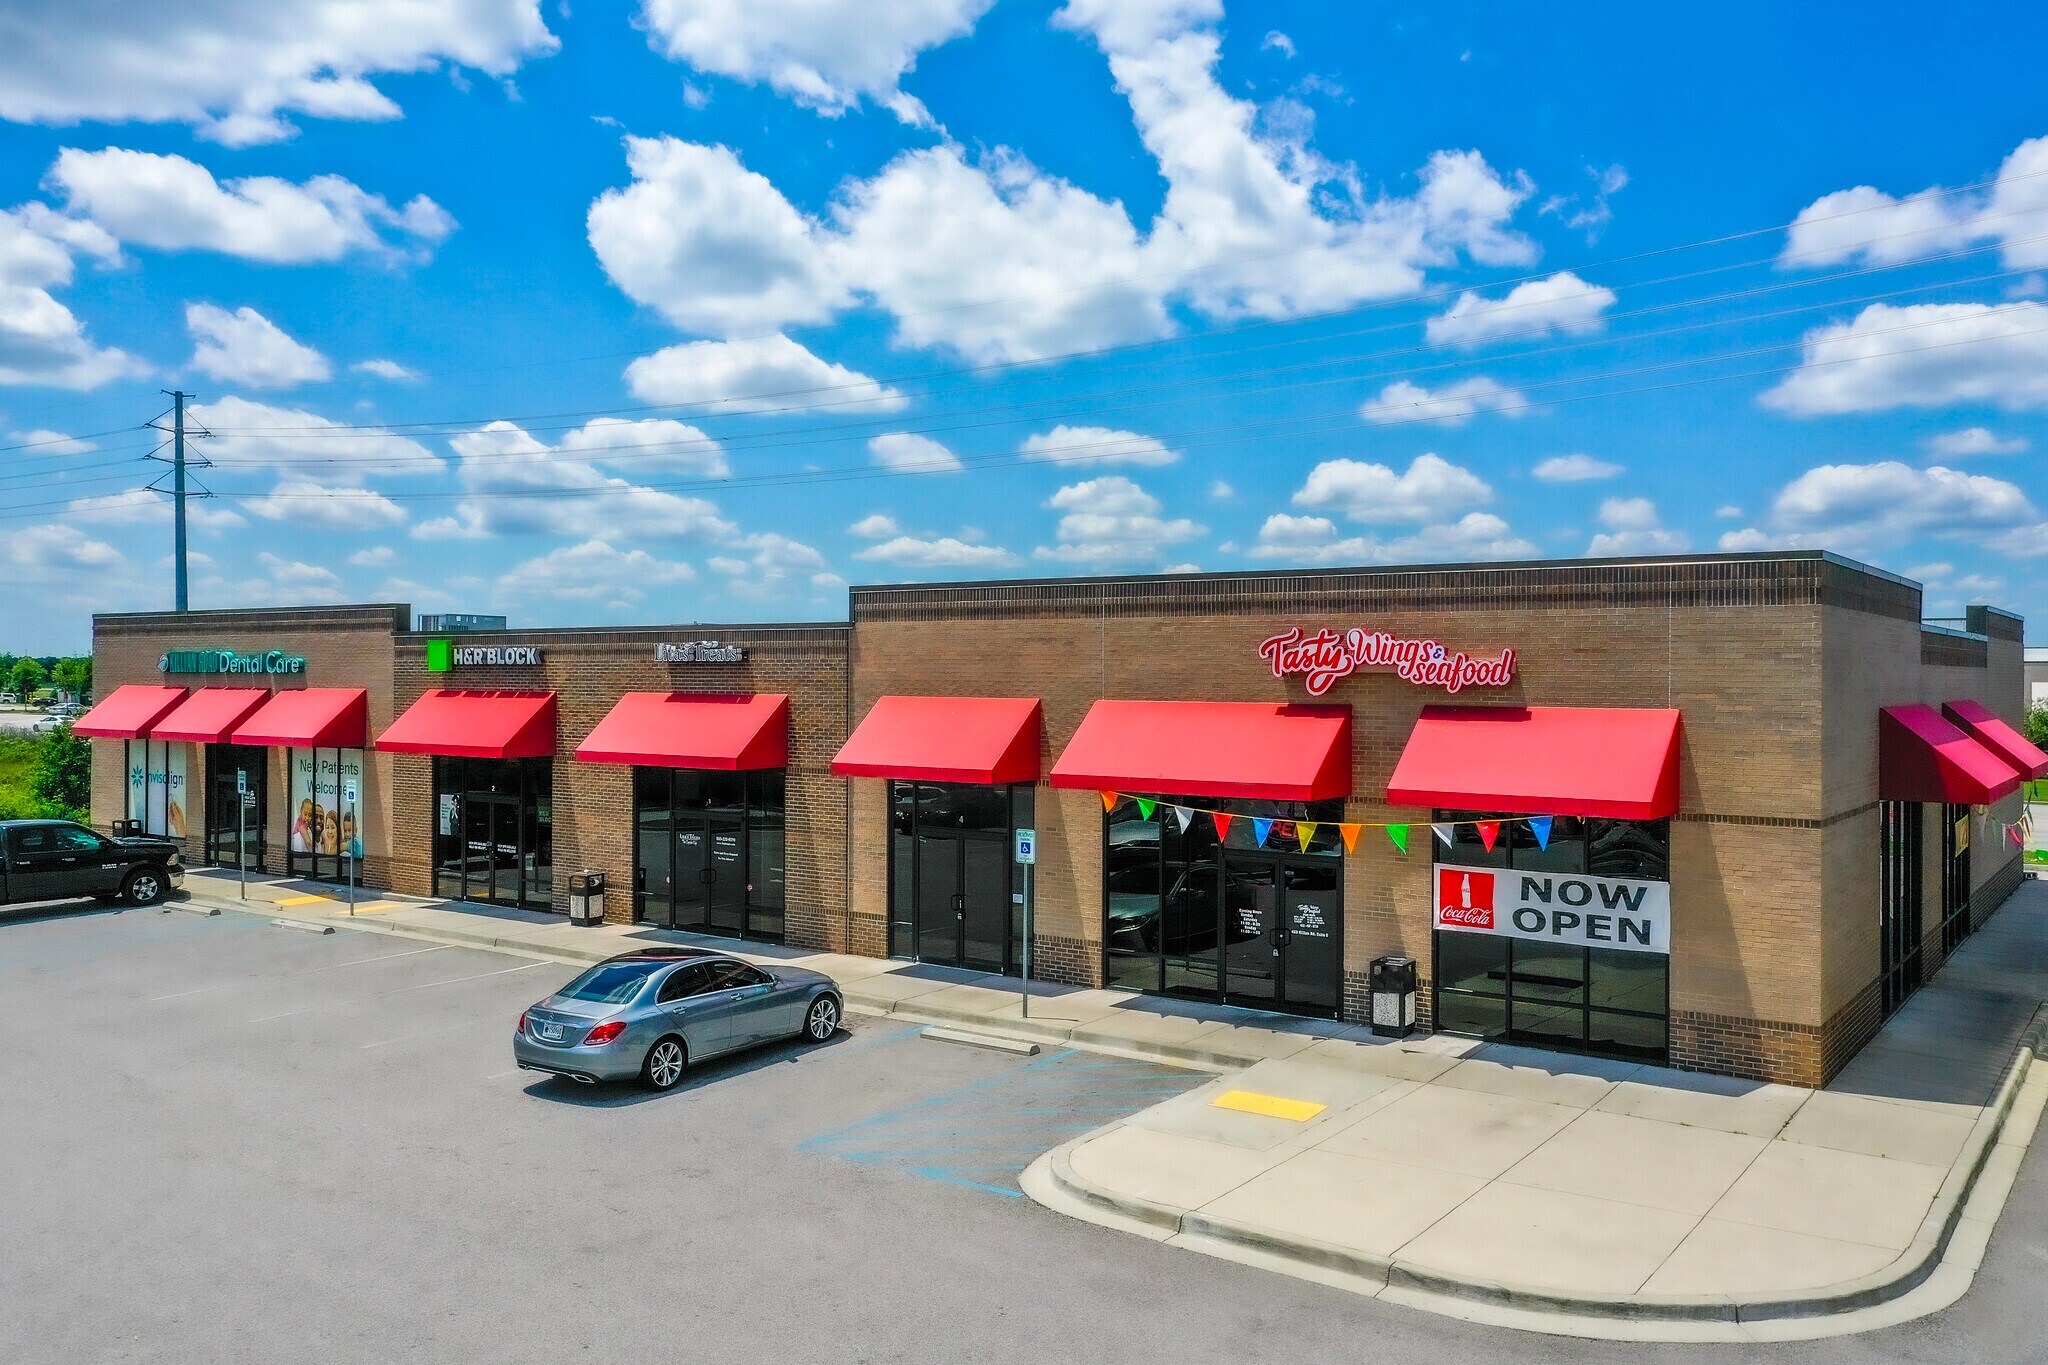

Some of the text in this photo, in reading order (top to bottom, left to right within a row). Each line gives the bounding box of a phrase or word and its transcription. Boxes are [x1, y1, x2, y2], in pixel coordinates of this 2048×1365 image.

[453, 647, 538, 665] H&R BLOCK
[692, 640, 738, 661] Treats
[1260, 628, 1443, 694] Tasty Wings &
[219, 651, 263, 673] Dental
[266, 651, 300, 673] Care
[322, 760, 359, 775] Patents
[959, 815, 964, 823] 4
[1520, 876, 1648, 912] NOW
[1440, 905, 1492, 925] Coca-Cola
[1512, 907, 1651, 946] OPEN
